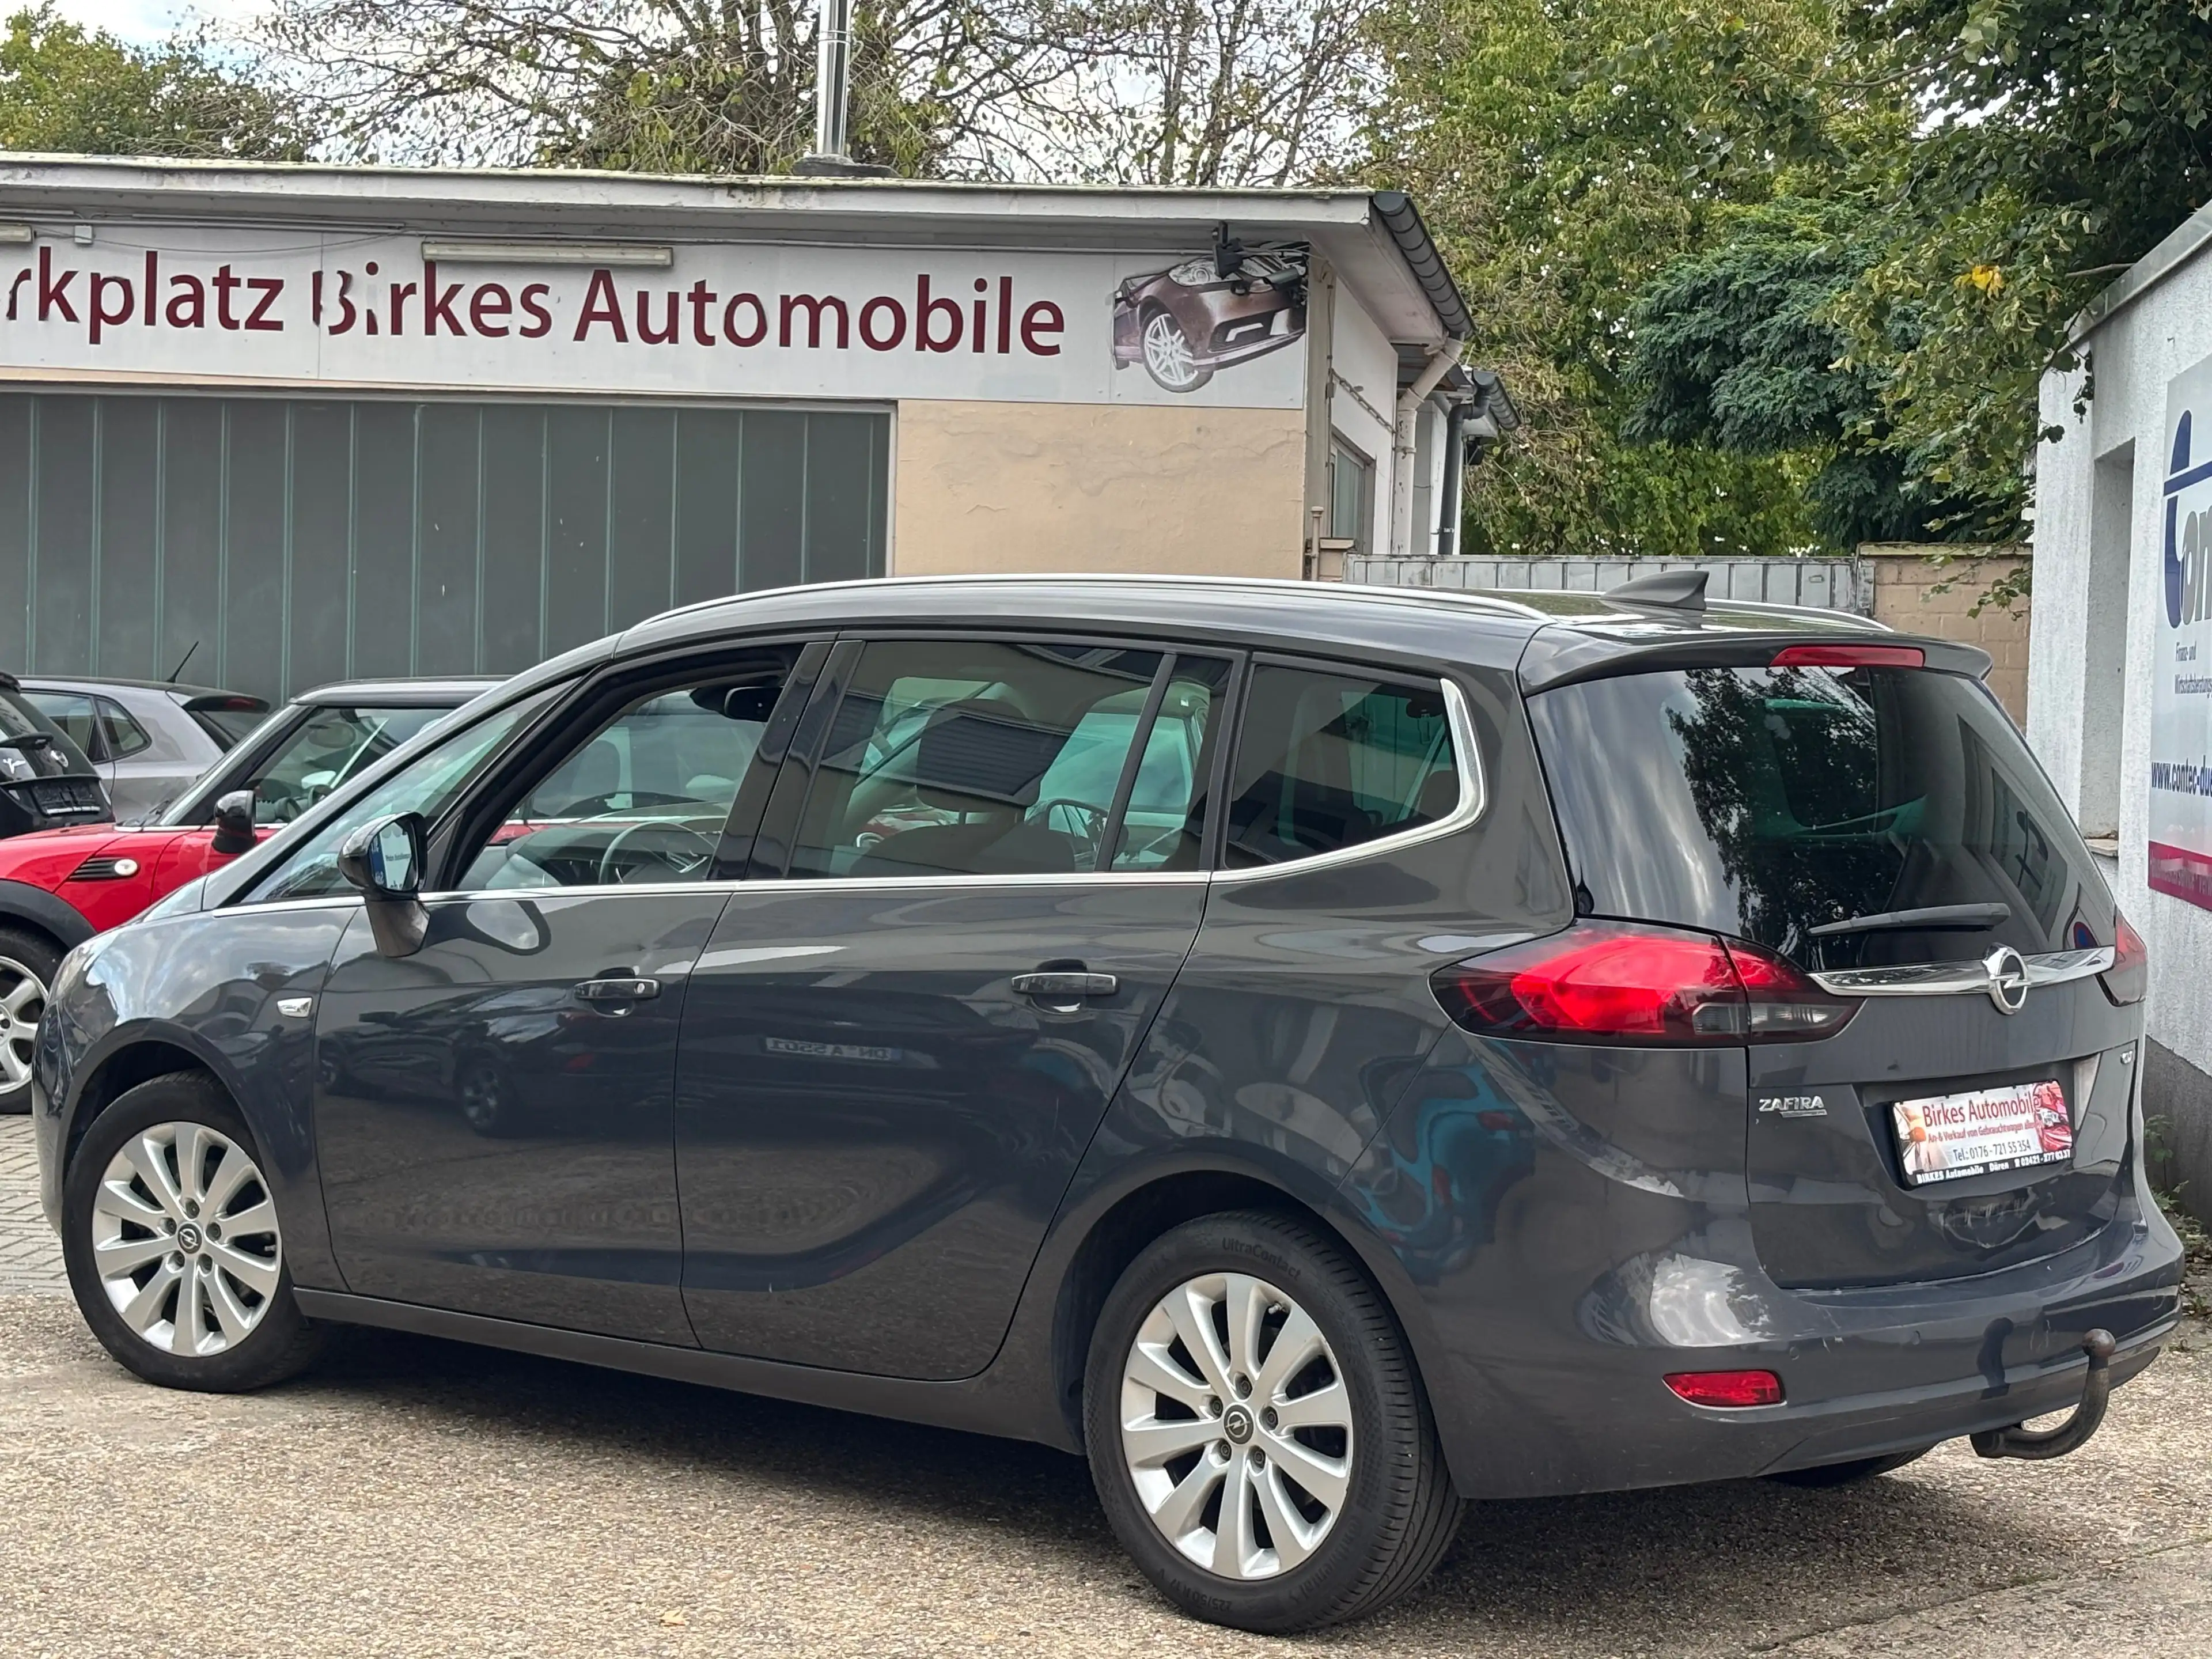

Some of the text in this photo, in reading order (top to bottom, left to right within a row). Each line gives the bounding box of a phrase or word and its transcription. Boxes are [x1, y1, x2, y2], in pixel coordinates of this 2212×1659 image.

[312, 260, 552, 338] Birkes
[574, 268, 1063, 356] Automobile
[1759, 1096, 1824, 1112] ZAFIRA
[1922, 1092, 2040, 1127] Birkes Automobile
[1943, 1128, 1966, 1140] Verkauf
[1968, 1145, 1988, 1158] 0176
[1993, 1142, 2006, 1154] 721
[1916, 1171, 1944, 1184] BIRKES
[1945, 1165, 1984, 1179] Automobile
[1988, 1161, 2009, 1172] Düren
[1222, 1237, 1302, 1281] UltraContact
[1192, 1591, 1233, 1612] 225/50
